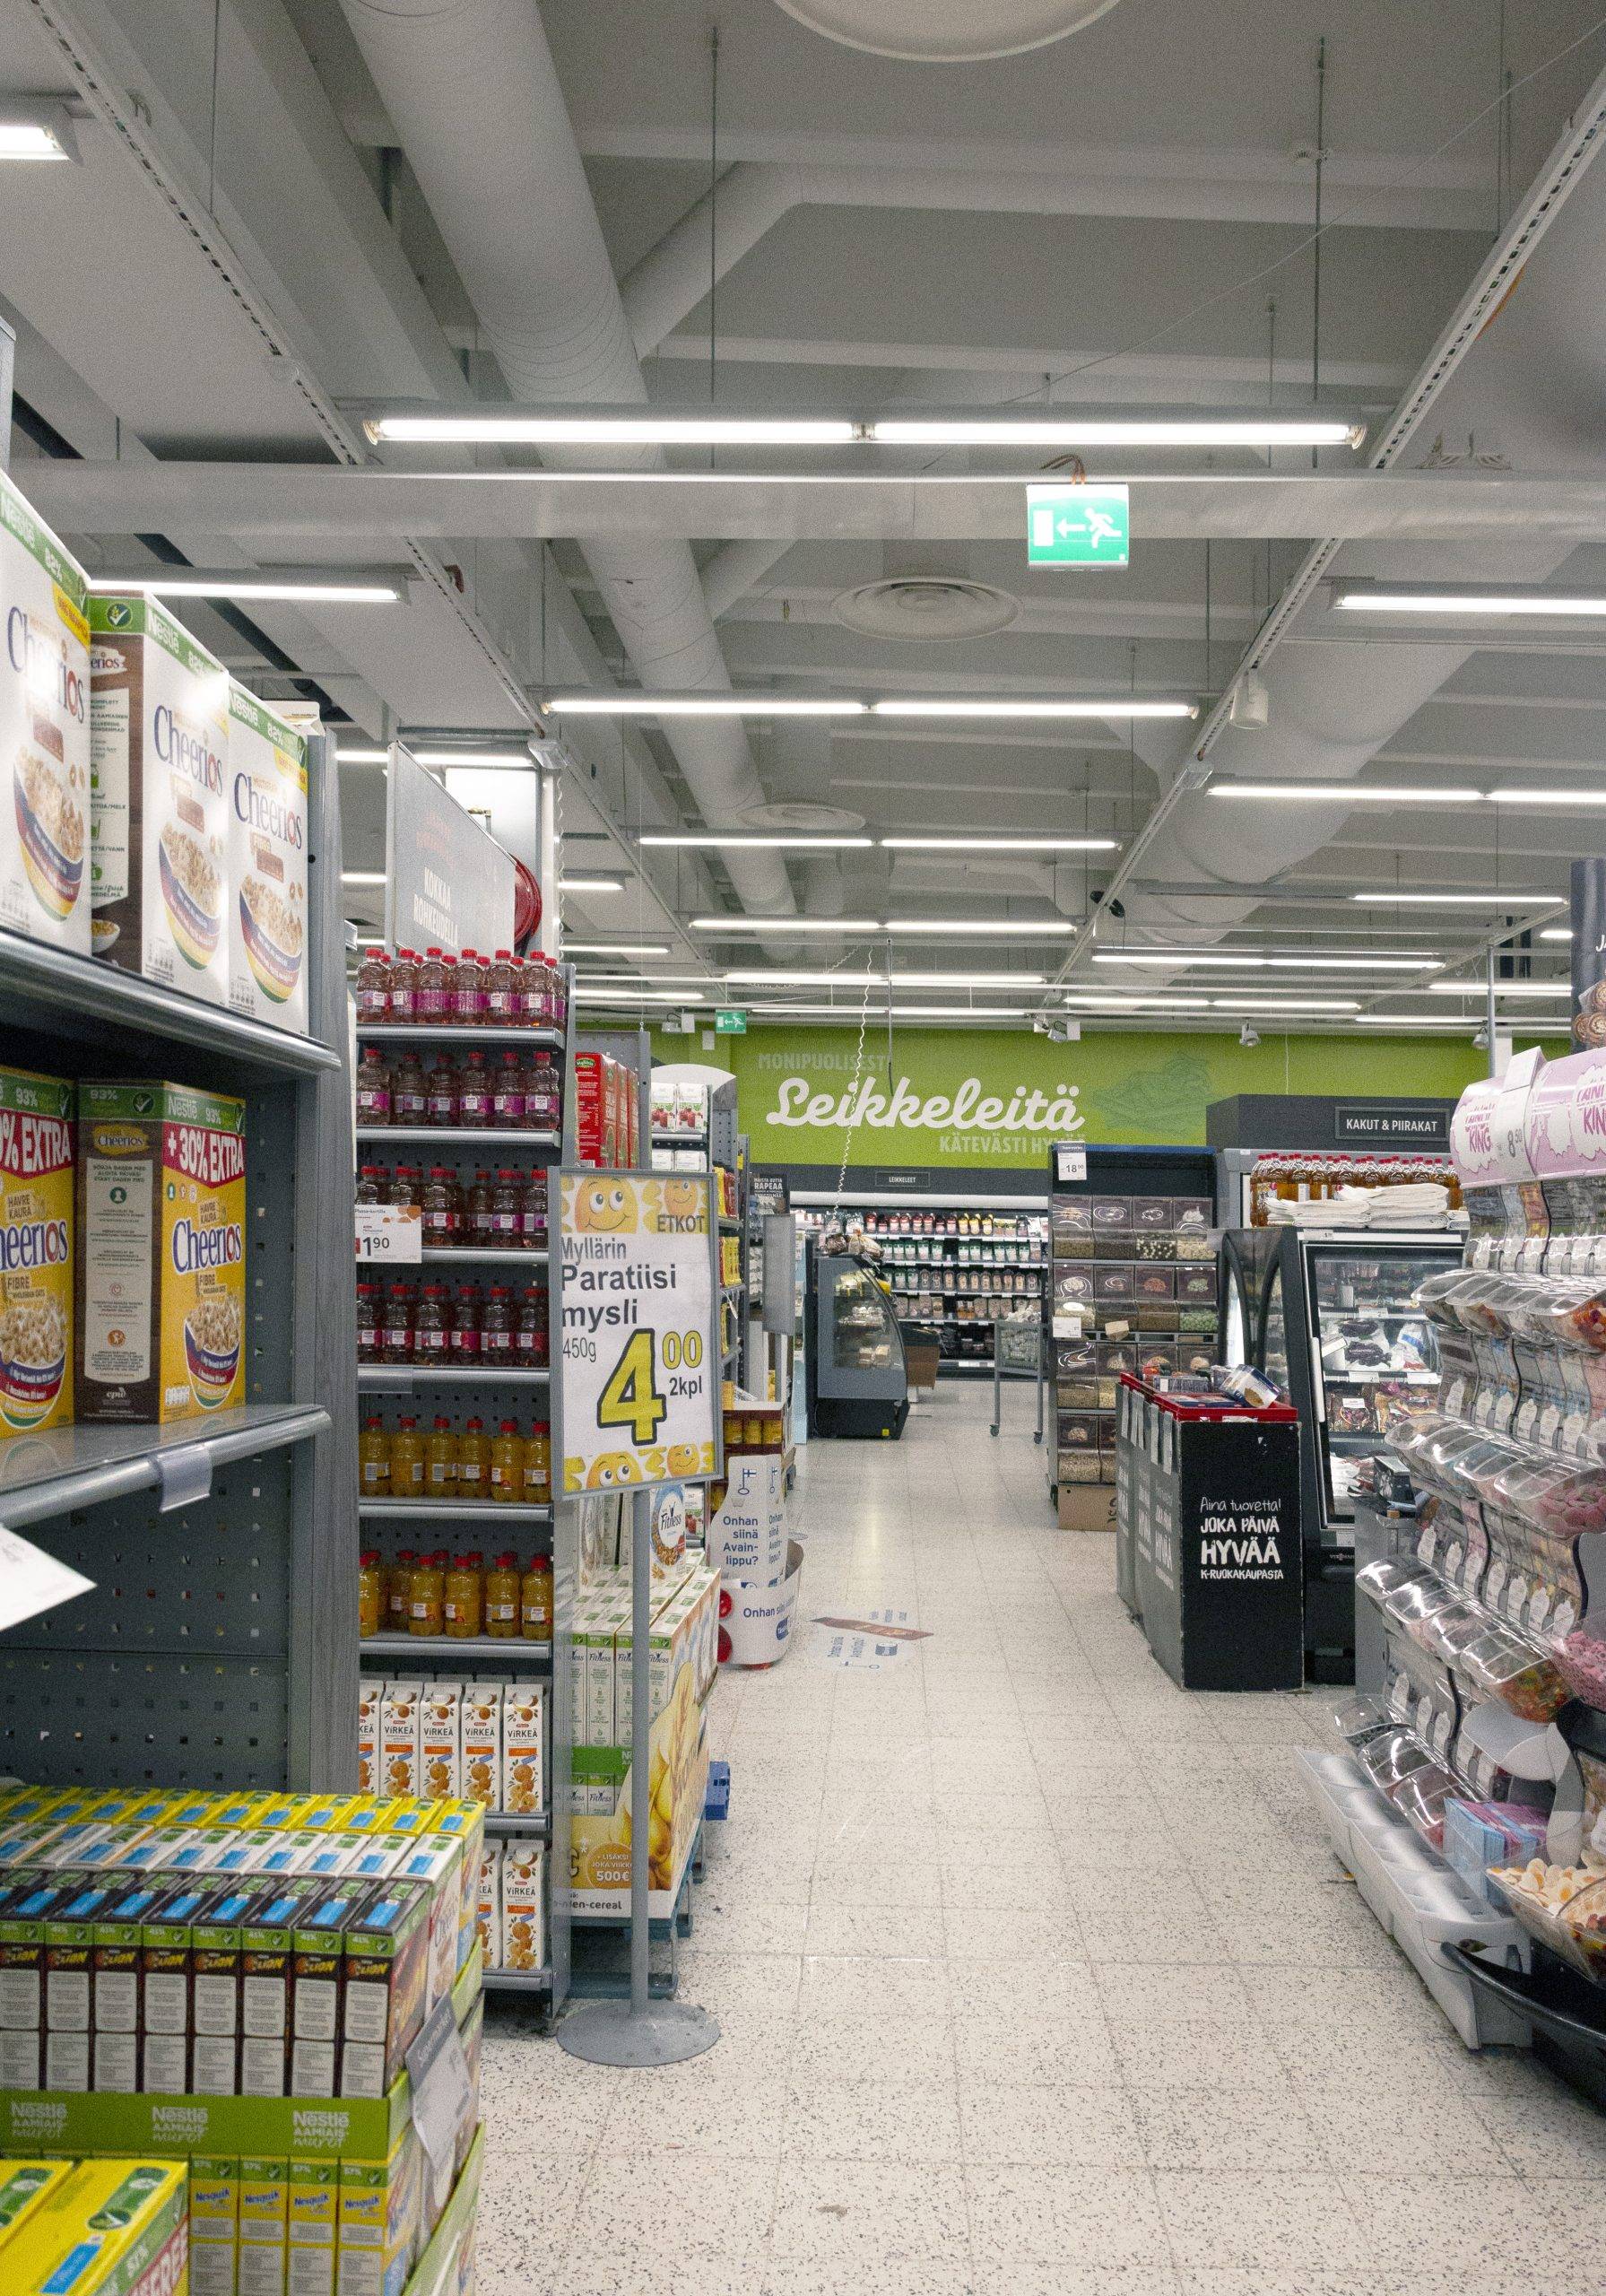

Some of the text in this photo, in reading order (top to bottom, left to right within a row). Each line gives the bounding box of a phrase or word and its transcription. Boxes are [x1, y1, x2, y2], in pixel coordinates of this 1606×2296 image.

[154, 705, 223, 797] Cheerios
[234, 772, 302, 850] Cheerios
[15, 1087, 39, 1108] 93%
[766, 1076, 1087, 1132] Leikkeleitä
[168, 1094, 198, 1120] Nestlé
[1346, 1118, 1438, 1132] KAKUT & PIIRAKAT
[1583, 1104, 1606, 1136] KIN
[22, 1116, 73, 1172] EXTRA
[98, 1135, 143, 1148] Cheerios
[939, 1132, 1028, 1154] KÄTEVÄSTI
[1467, 1126, 1492, 1153] KING
[179, 1127, 209, 1181] 30%
[209, 1132, 245, 1183] EXTRA
[754, 1182, 783, 1190] RAPEAA
[8, 1194, 30, 1209] HAVRE
[9, 1206, 32, 1221] KAURA
[173, 1220, 242, 1274] Cheerios
[561, 1236, 628, 1265] Myllärin
[7, 1275, 30, 1290] FIBRE
[561, 1263, 677, 1292] Paratiisi
[561, 1300, 638, 1333] mysli
[562, 1336, 597, 1362] 450g
[668, 1376, 703, 1399] 2kpl
[1201, 1496, 1281, 1513] Aina tuoretta!
[723, 1516, 759, 1526] Onhan
[768, 1513, 783, 1525] Onhan
[1201, 1516, 1280, 1534] JOKA PÄIVÄ
[733, 1529, 759, 1539] siinä
[723, 1542, 759, 1552] Avain-
[1201, 1536, 1281, 1567] HYVÄÄ
[725, 1555, 759, 1567] lippu?
[1201, 1569, 1284, 1579] K-RUOKAKAUPASTA
[743, 1607, 776, 1618] Onhan
[588, 1652, 612, 1663] Fitness
[588, 1792, 612, 1803] Fitness
[603, 1853, 629, 1861] LISÄKSI
[596, 1870, 630, 1883] 500€
[152, 2106, 208, 2123] Nestlé
[292, 2110, 350, 2128] Nestlé
